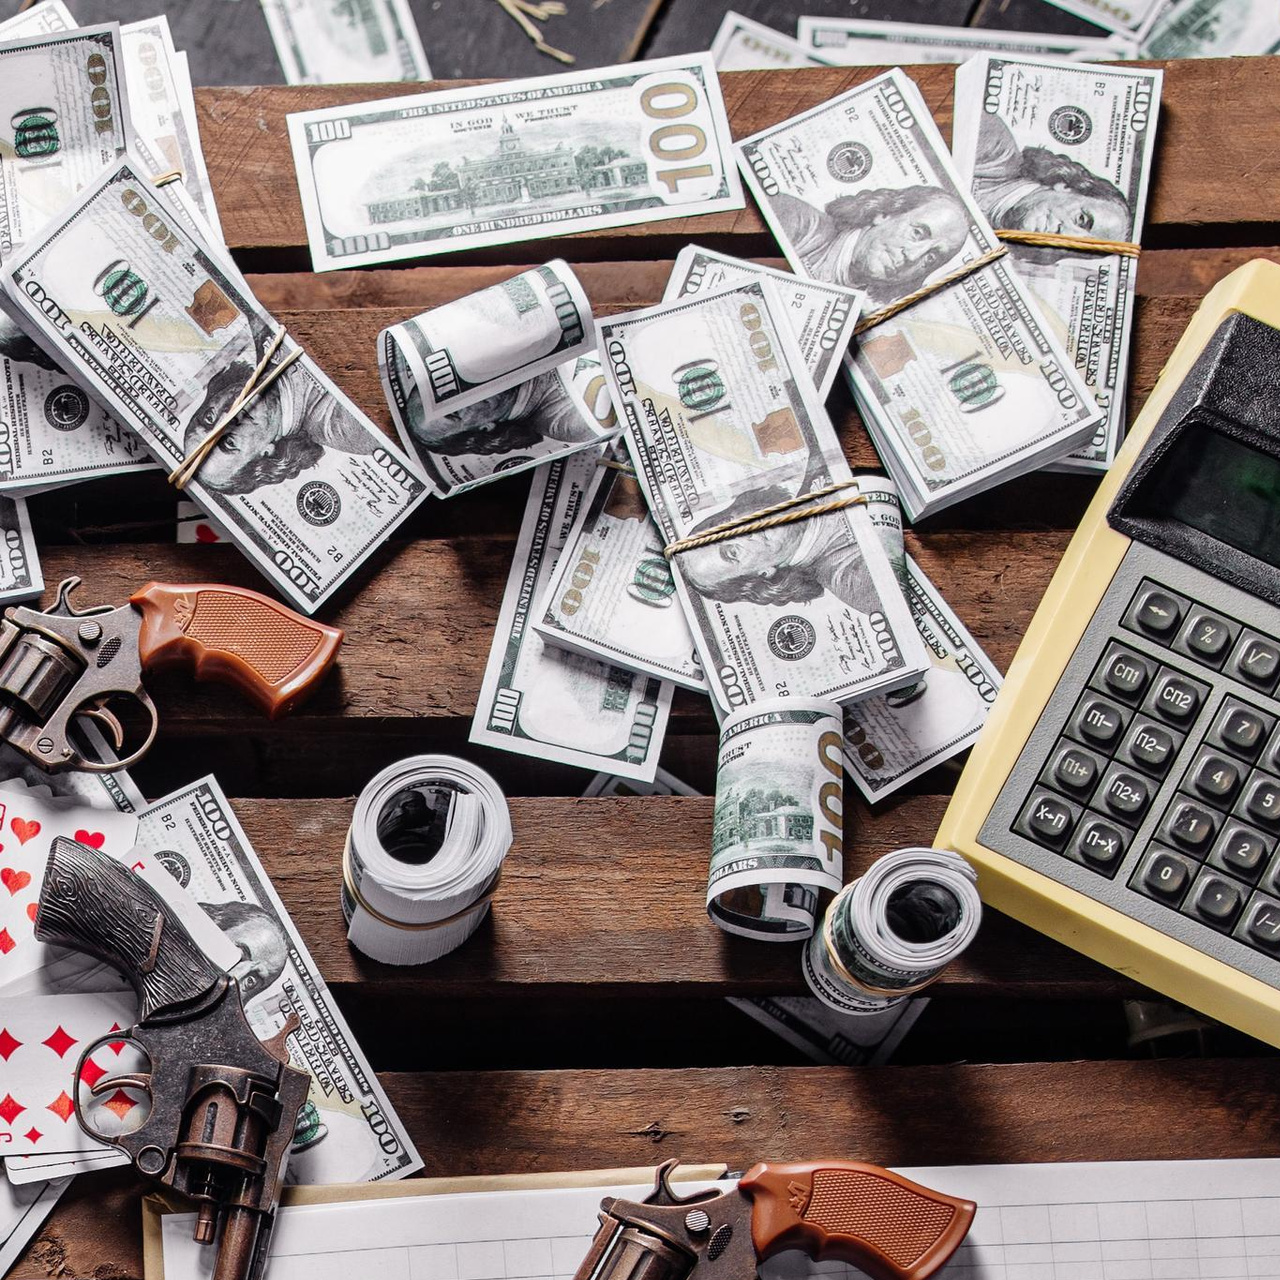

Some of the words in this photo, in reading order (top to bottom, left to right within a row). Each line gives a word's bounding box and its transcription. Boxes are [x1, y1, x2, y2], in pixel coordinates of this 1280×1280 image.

[86, 51, 114, 135] 100
[879, 83, 915, 131] 100
[984, 66, 1002, 115] 100
[1092, 81, 1106, 97] B2
[1129, 80, 1151, 133] 100
[308, 118, 352, 144] 100
[466, 117, 494, 128] GOD
[536, 105, 579, 118] TRUST
[843, 106, 860, 123] B2
[640, 82, 713, 194] 100
[745, 149, 781, 197] 100
[118, 186, 180, 253] 100
[24, 279, 71, 331] 100
[790, 292, 806, 309] B2
[3, 357, 12, 385] NOTE
[425, 349, 460, 400] 100
[606, 339, 638, 398] 100
[1040, 361, 1078, 410] 100
[6, 385, 17, 428] RESERVE
[11, 427, 22, 469] FEDERAL
[40, 447, 54, 465] B2
[370, 445, 416, 494] 100
[239, 494, 260, 517] NOTE
[563, 482, 580, 519] TRUST
[258, 513, 292, 550] RESERVE
[2, 527, 28, 582] 100
[290, 547, 322, 582] FEDERAL
[326, 544, 343, 562] B2
[273, 547, 319, 597] 100
[865, 608, 901, 662] 100
[1200, 625, 1217, 644] %
[1113, 663, 1140, 684] СП1
[490, 688, 522, 733] 100
[1162, 686, 1192, 709] СП2
[1237, 720, 1251, 734] 7
[1062, 757, 1089, 777] П1+
[1212, 770, 1224, 784] 4
[1111, 780, 1141, 803] П2+
[1262, 794, 1275, 808] 5
[161, 813, 176, 831] B2
[196, 789, 230, 842] 100
[1188, 819, 1198, 832] 1
[189, 801, 212, 839] FEDERAL
[209, 837, 233, 879] RESERVE
[230, 877, 246, 902] NOTE
[1237, 843, 1251, 857] 2
[1160, 866, 1171, 881] 0
[362, 1099, 398, 1156] 100
